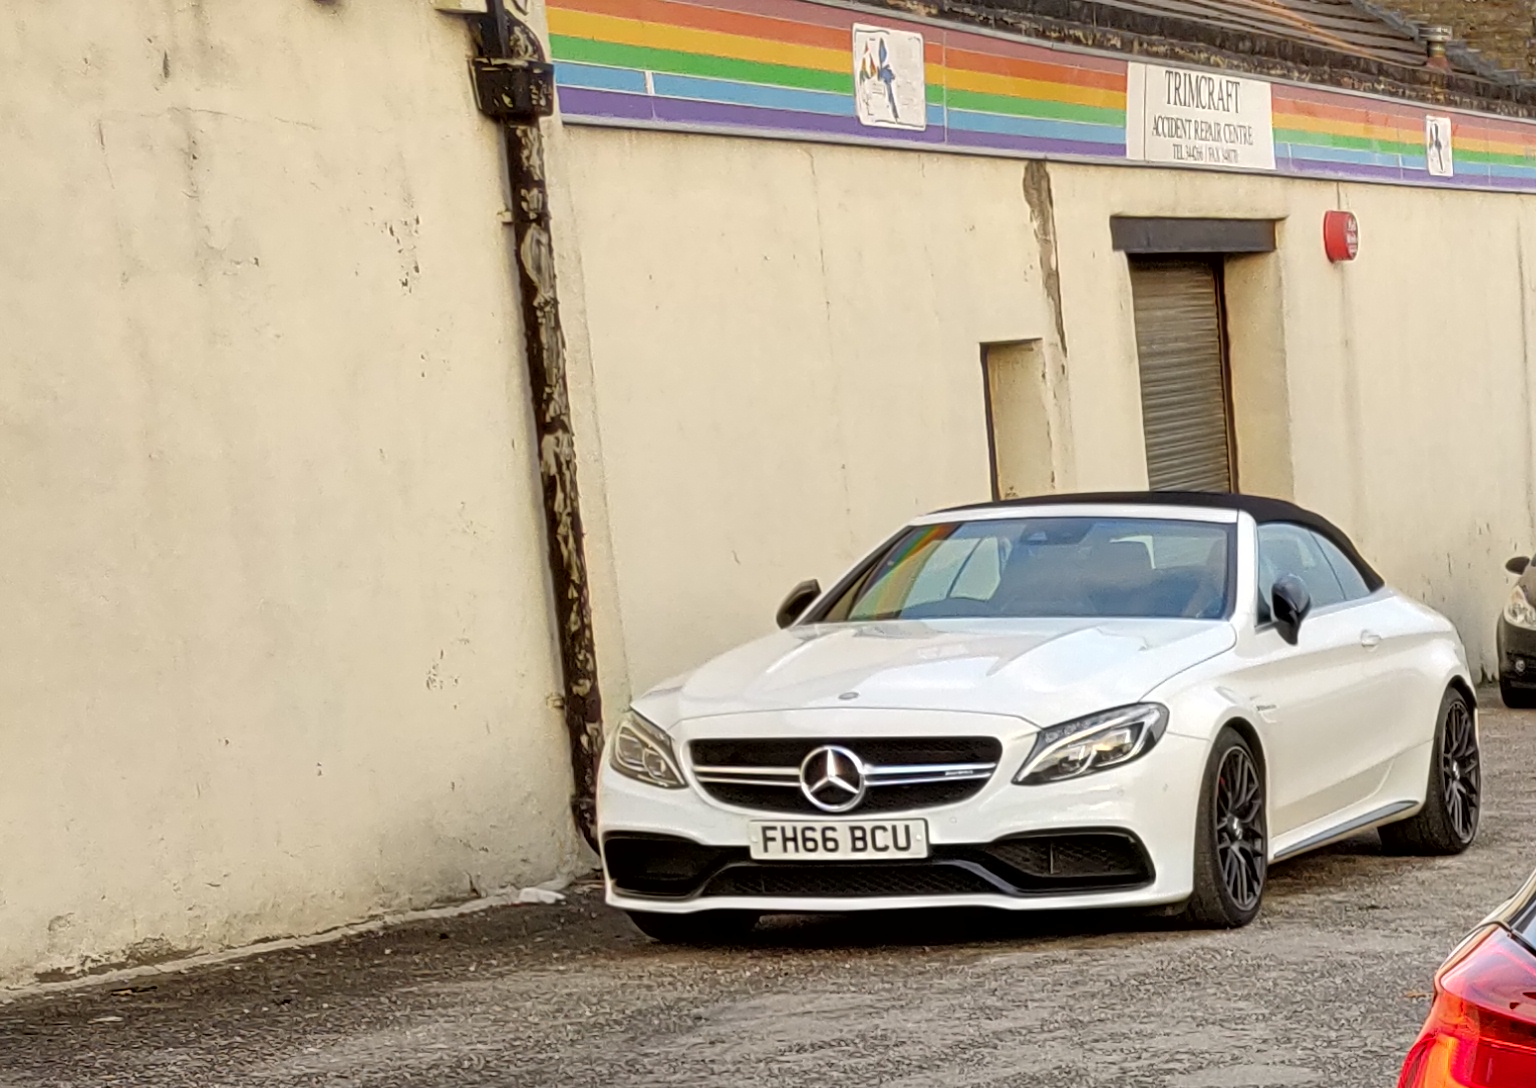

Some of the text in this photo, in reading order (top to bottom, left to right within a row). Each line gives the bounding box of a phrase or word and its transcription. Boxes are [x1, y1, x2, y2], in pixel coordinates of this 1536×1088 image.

[1164, 69, 1240, 114] TRIMCRAFT
[1152, 114, 1254, 146] ACCIDENT REPAIR CENTRE
[761, 824, 913, 853] FH66 BCU
